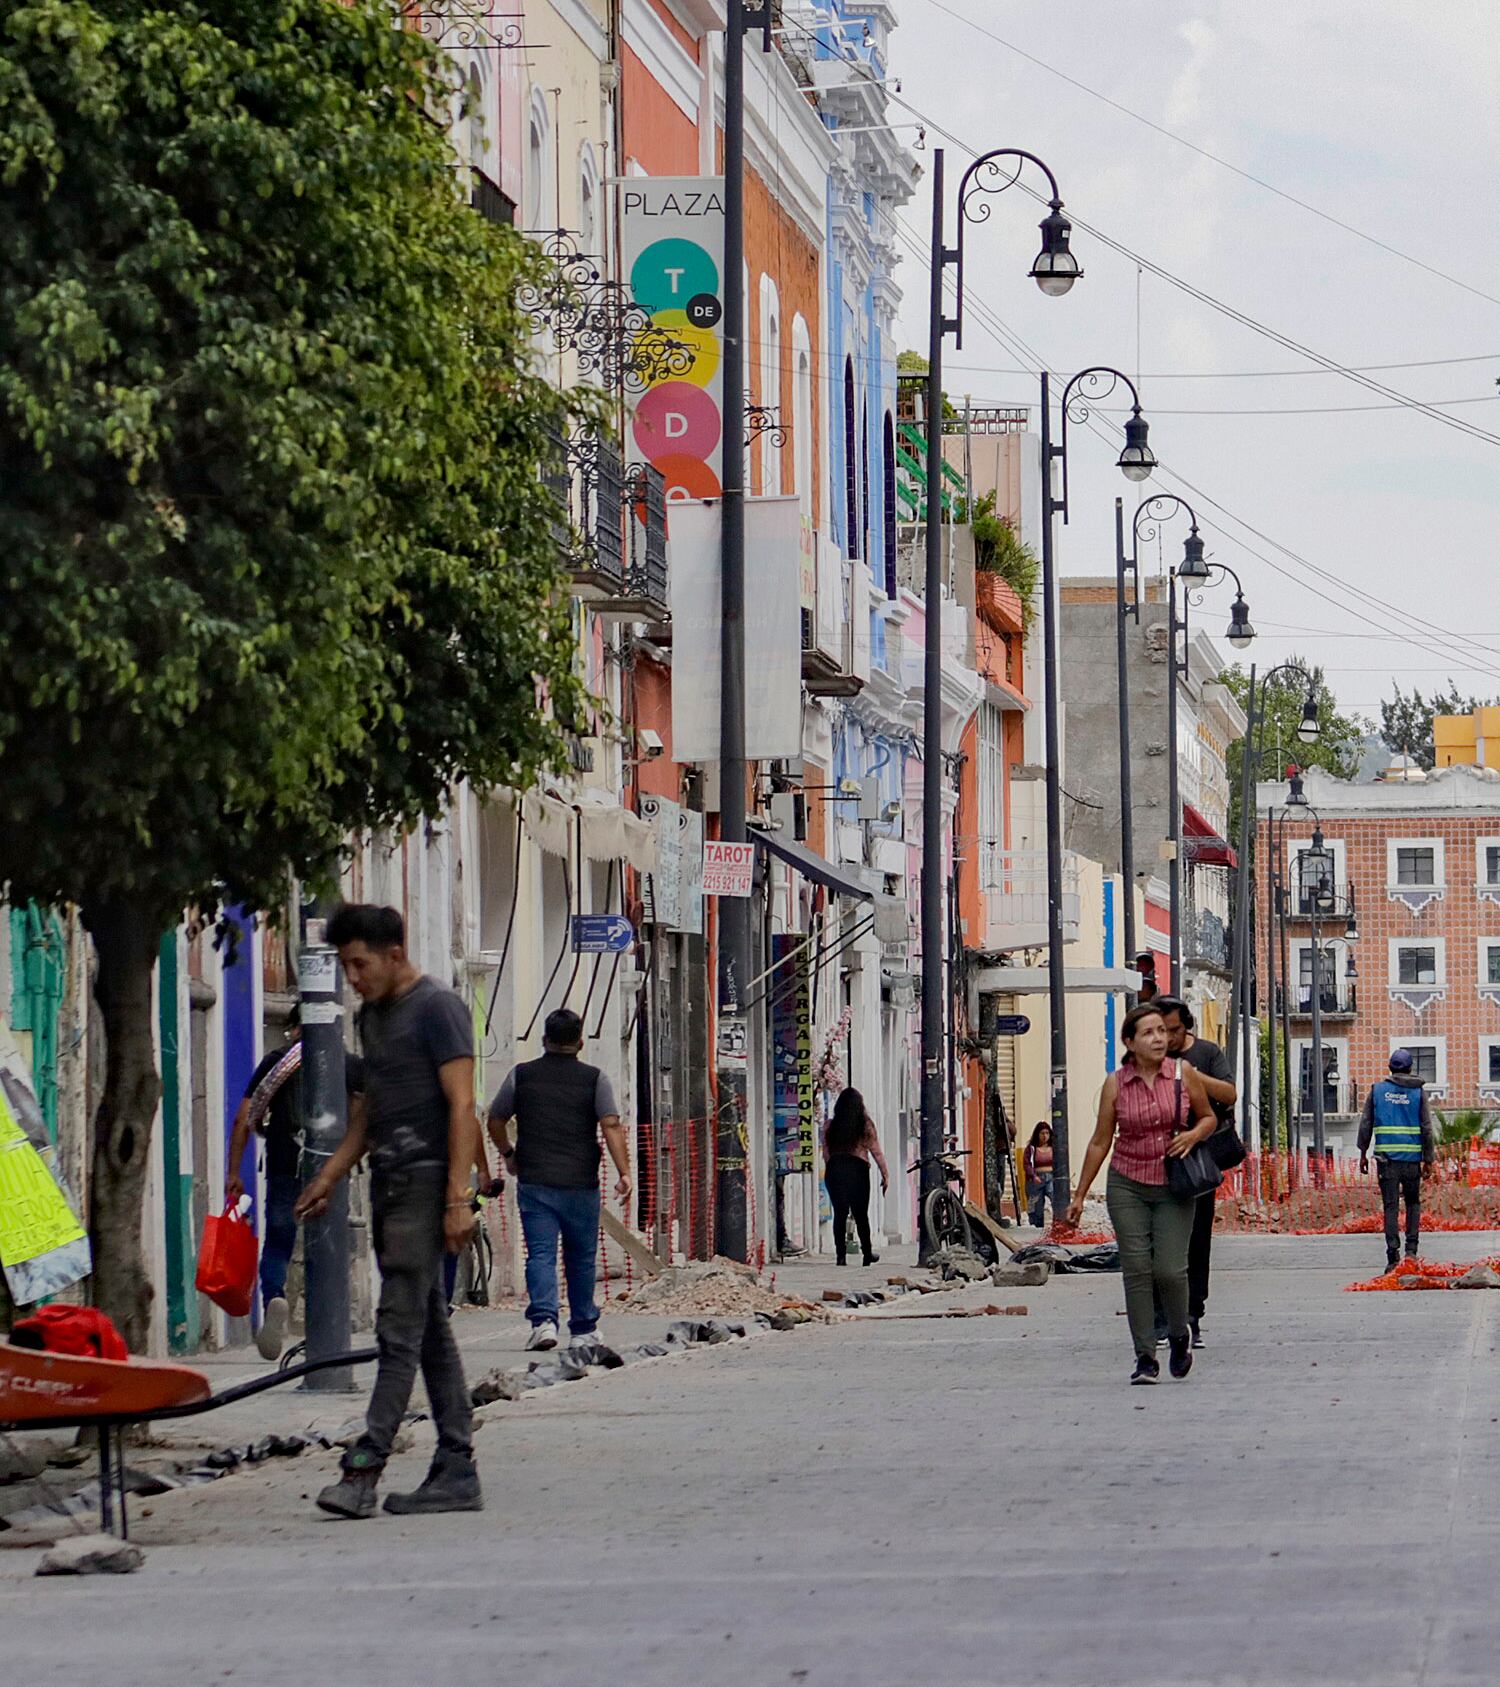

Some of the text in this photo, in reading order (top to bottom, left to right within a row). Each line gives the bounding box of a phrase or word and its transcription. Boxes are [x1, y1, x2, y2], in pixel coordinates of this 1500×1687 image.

[624, 192, 726, 216] PLAZA
[694, 306, 714, 317] DE
[705, 845, 752, 863] TAROT
